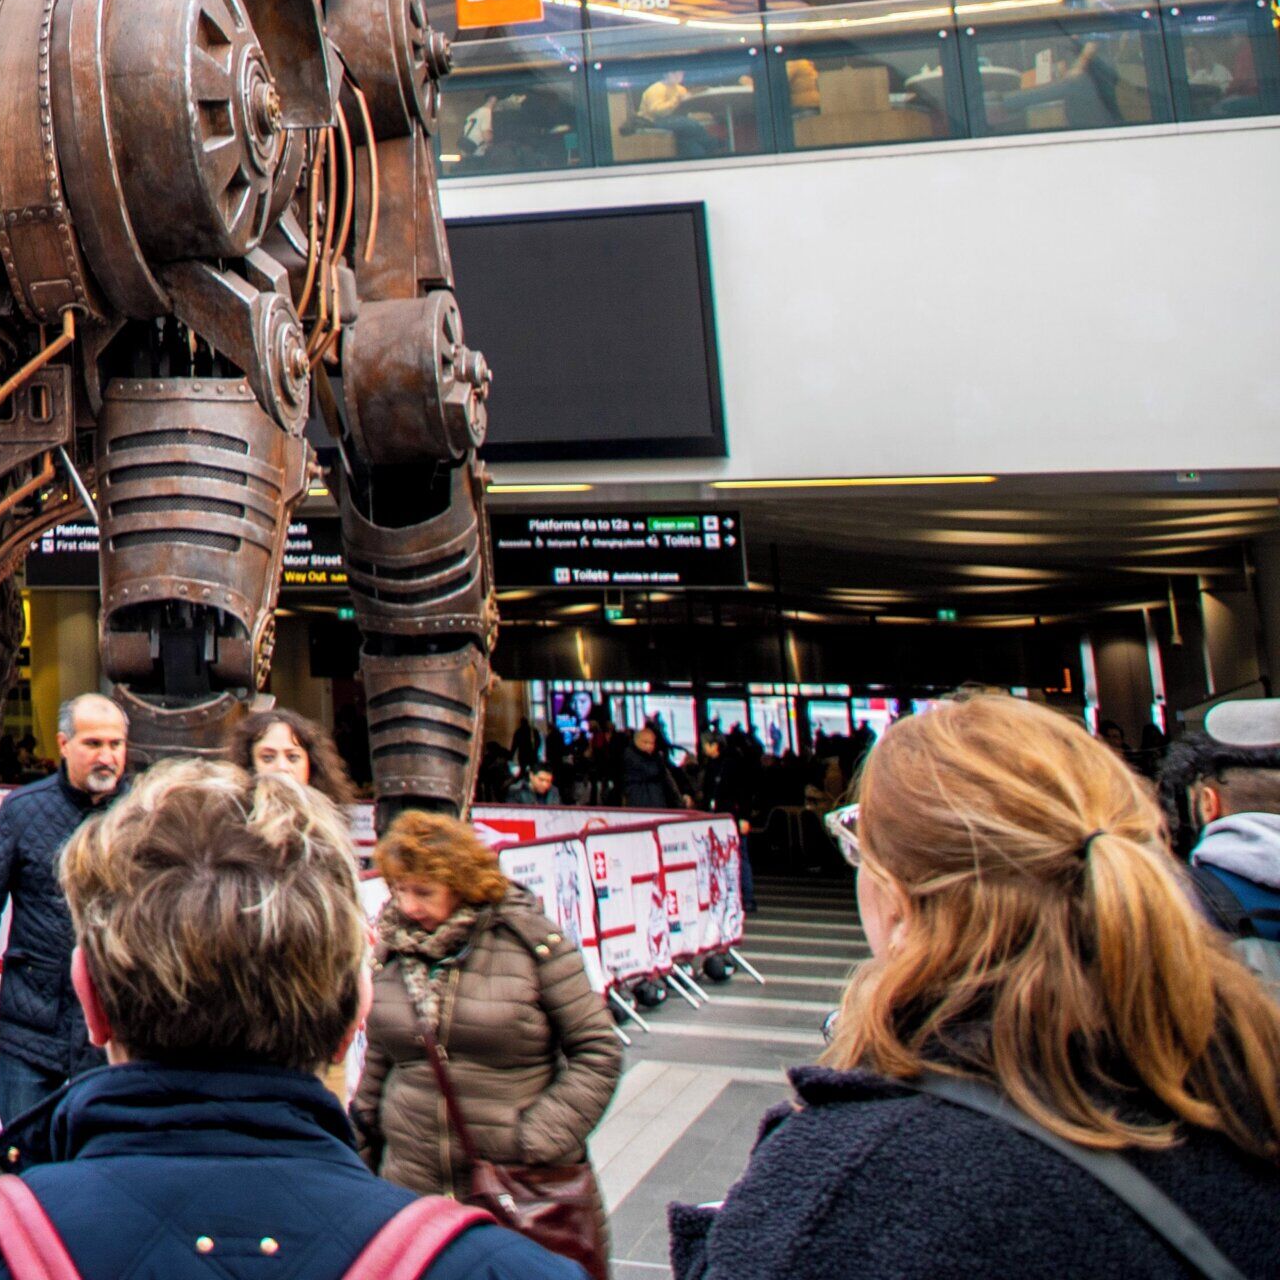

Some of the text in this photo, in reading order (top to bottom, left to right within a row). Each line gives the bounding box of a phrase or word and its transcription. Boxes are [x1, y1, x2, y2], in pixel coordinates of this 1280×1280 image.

[287, 522, 308, 535] axis
[529, 518, 581, 531] Platforms
[598, 518, 610, 531] to
[611, 518, 629, 531] 12a
[56, 540, 77, 552] First
[663, 534, 701, 548] Toilets
[283, 554, 342, 567] Moor Street
[285, 571, 307, 584] Way
[308, 570, 327, 583] Out
[572, 568, 609, 582] Toilets
